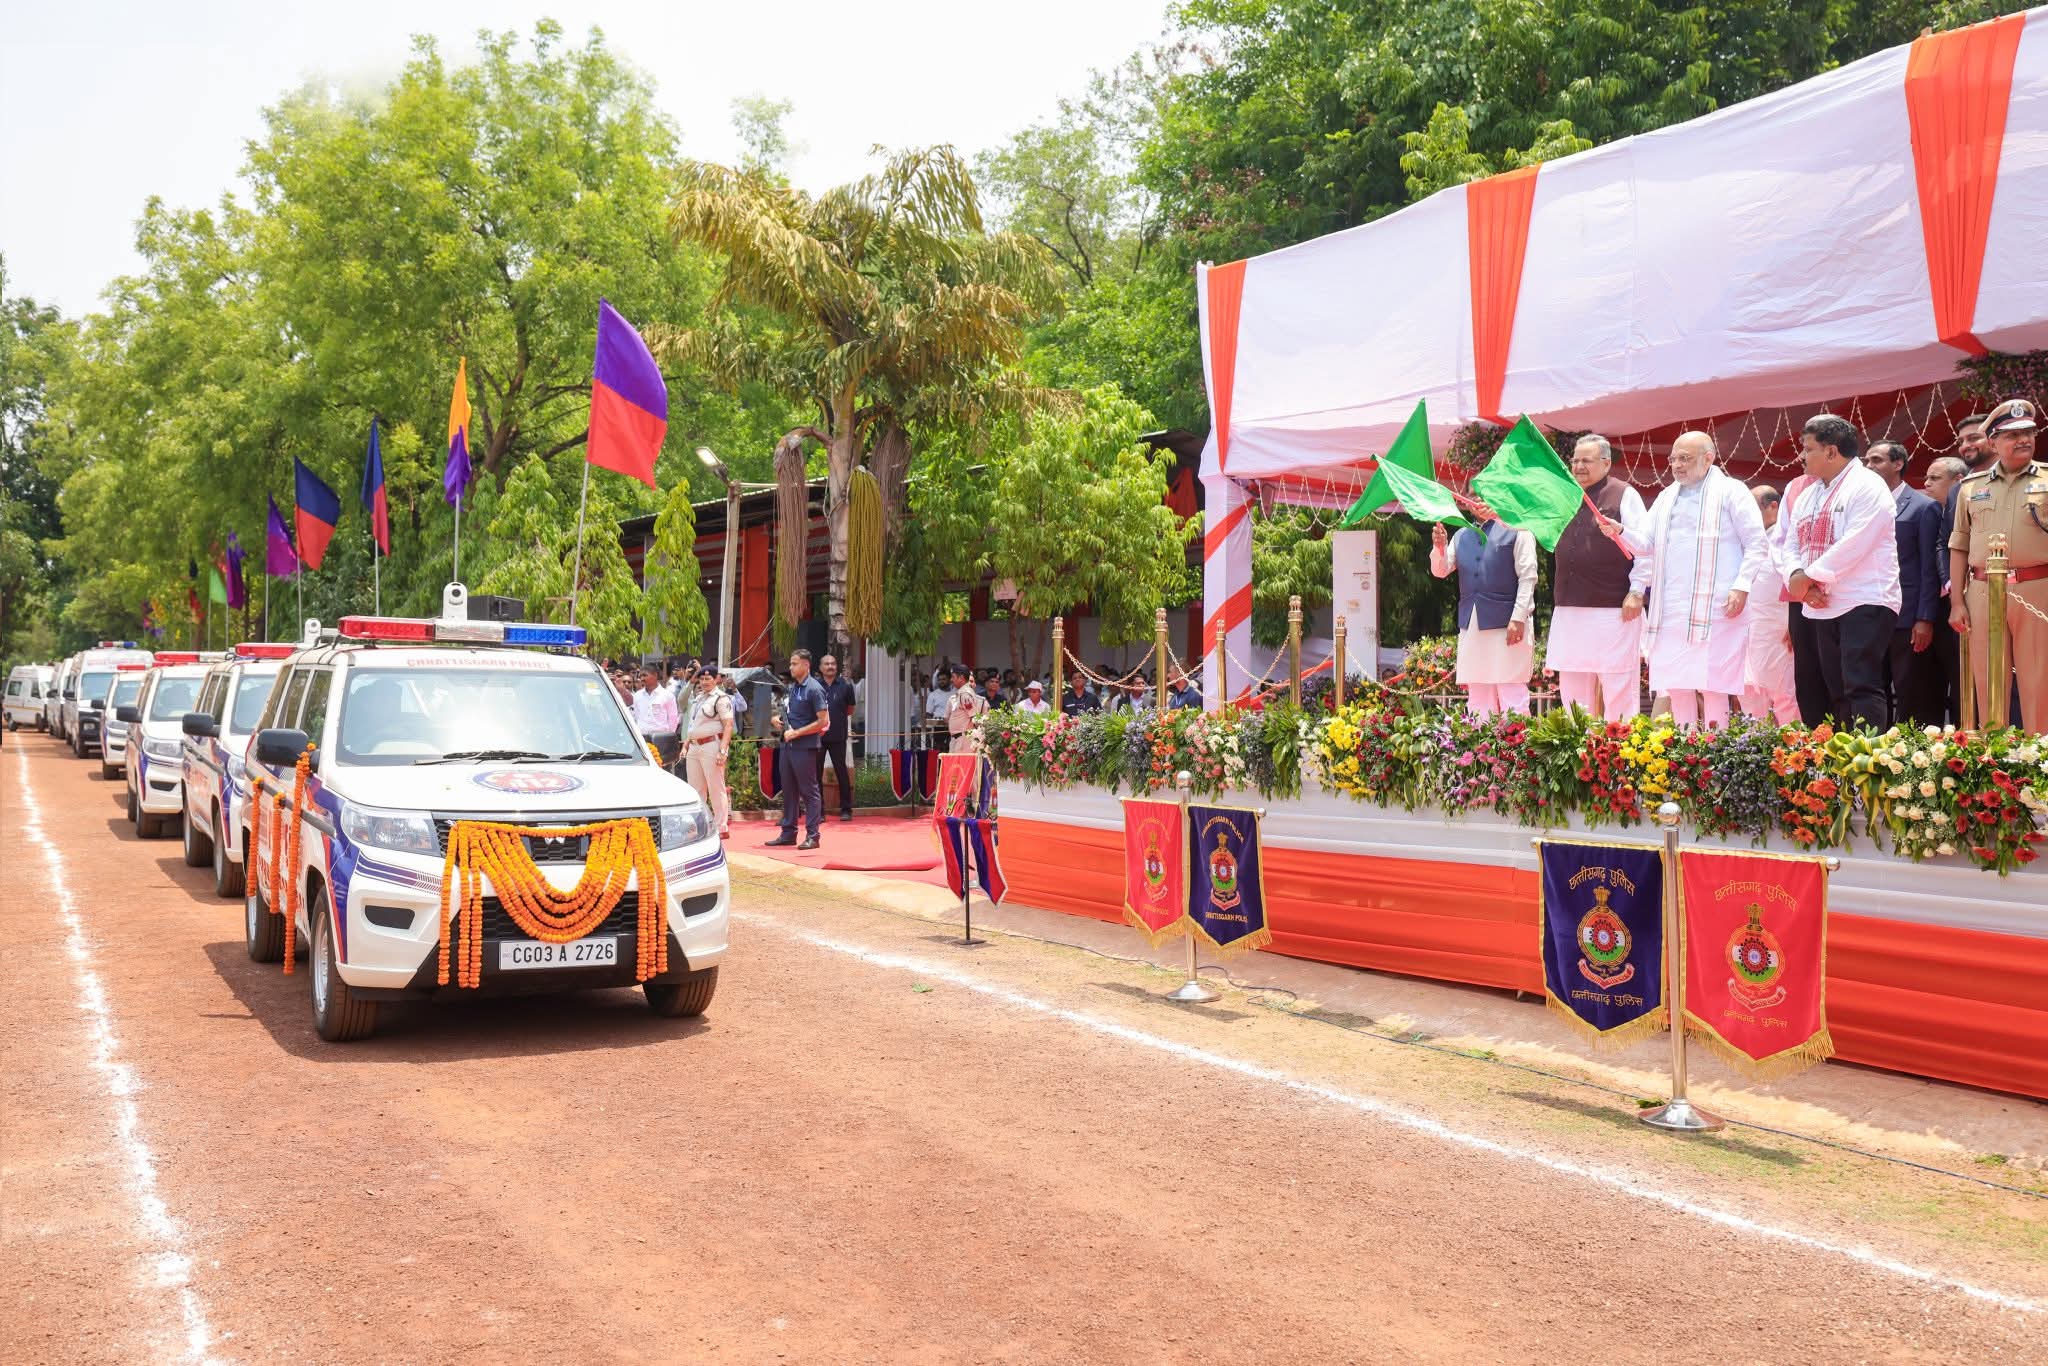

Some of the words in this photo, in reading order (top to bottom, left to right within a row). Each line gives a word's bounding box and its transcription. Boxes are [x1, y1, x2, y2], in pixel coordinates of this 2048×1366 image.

[1608, 868, 1636, 897] पुलिस
[1765, 884, 1798, 912] पुलिस
[512, 945, 553, 964] CG03
[559, 944, 567, 962] A
[575, 943, 614, 961] 2726
